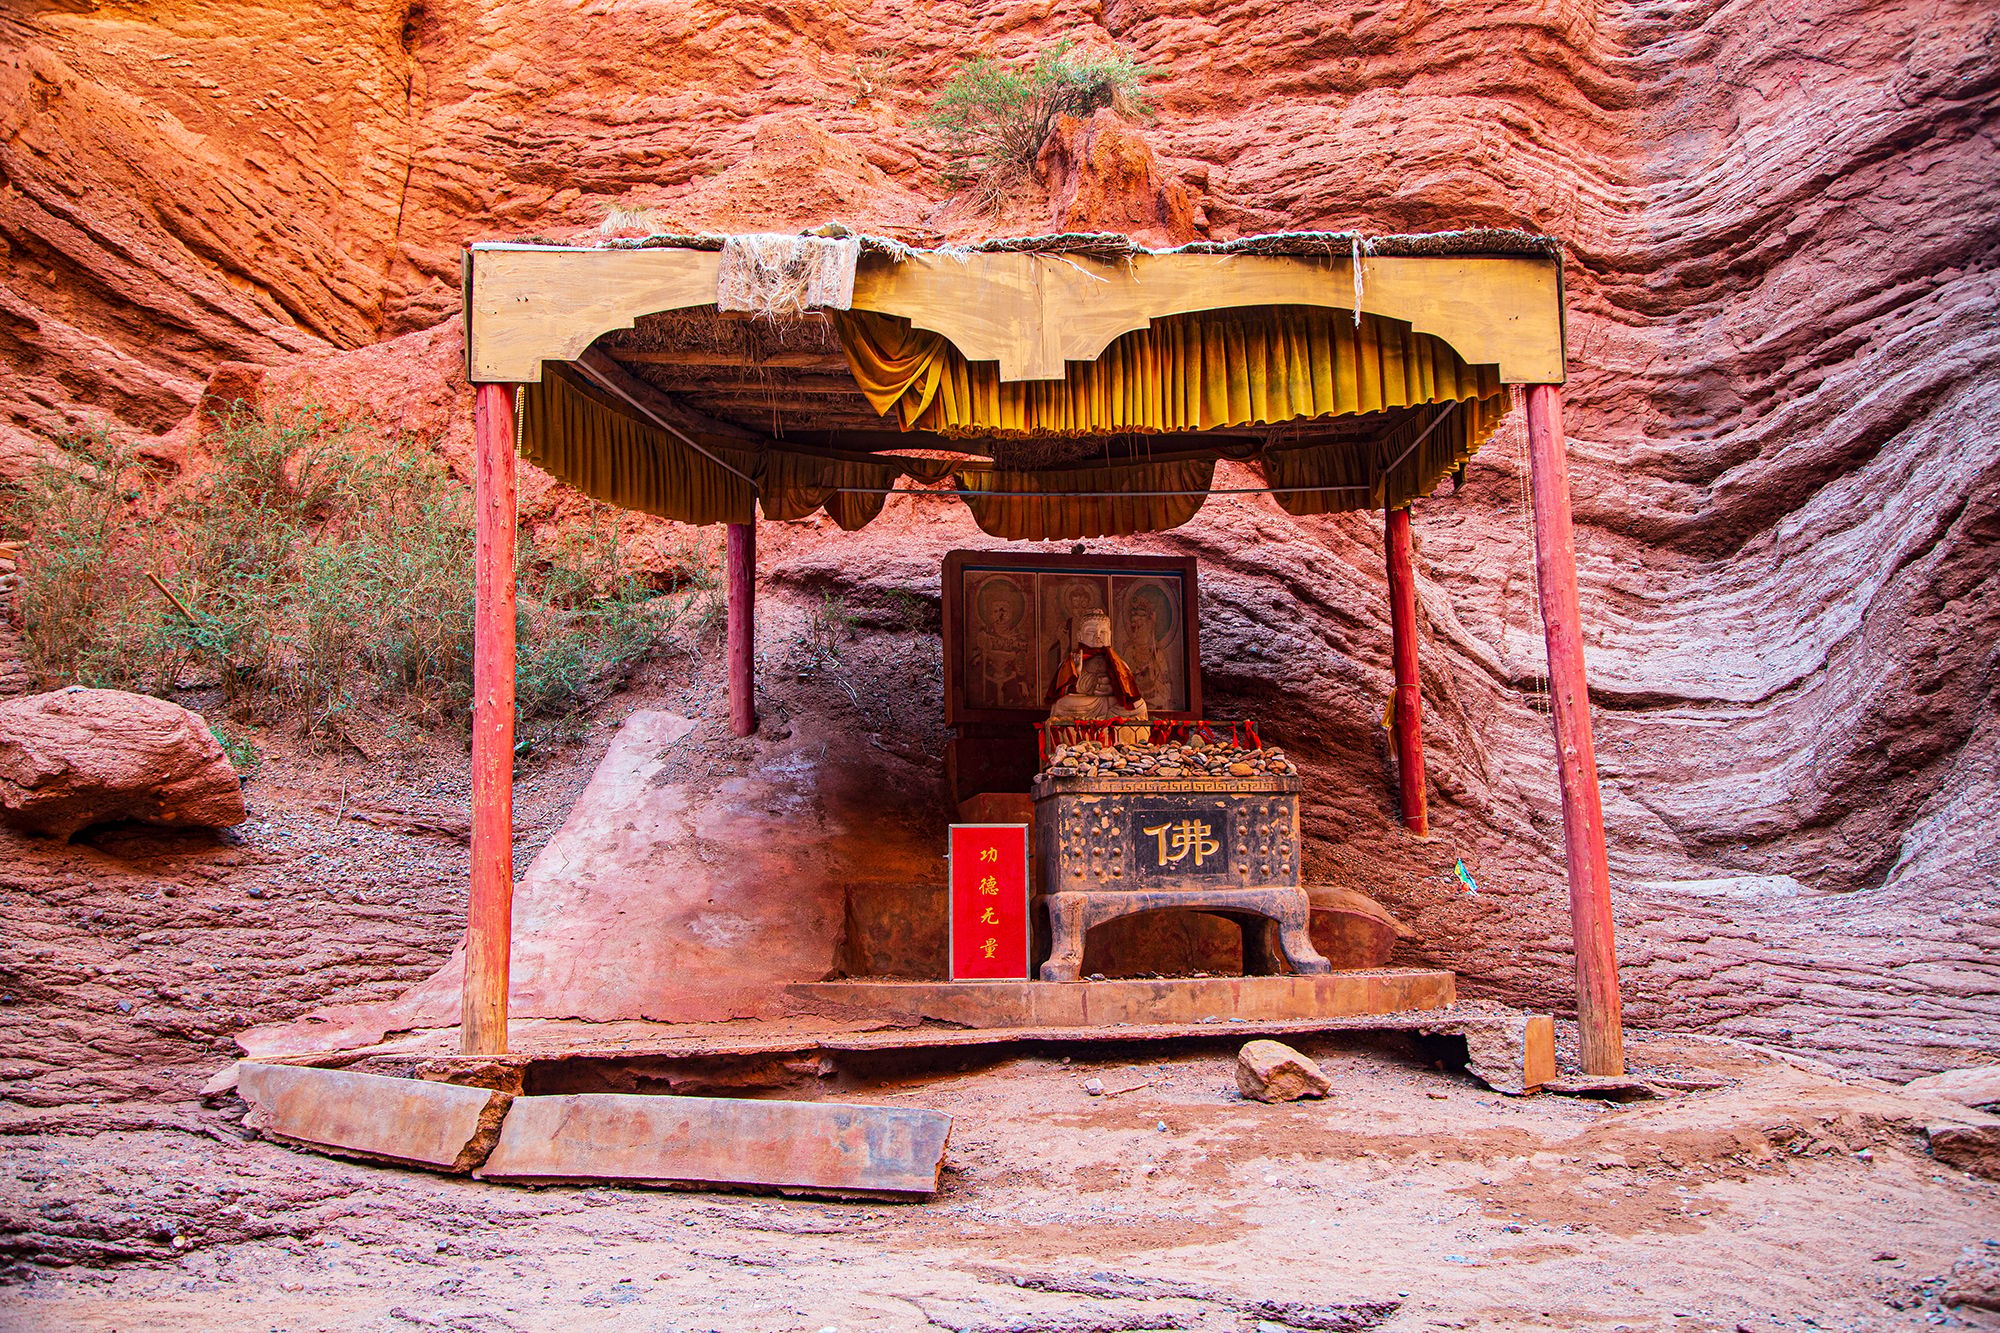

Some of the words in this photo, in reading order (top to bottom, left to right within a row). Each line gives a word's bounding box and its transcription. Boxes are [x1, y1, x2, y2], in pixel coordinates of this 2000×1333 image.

[1143, 819, 1220, 866] 佛
[978, 847, 1000, 959] 功德无量
